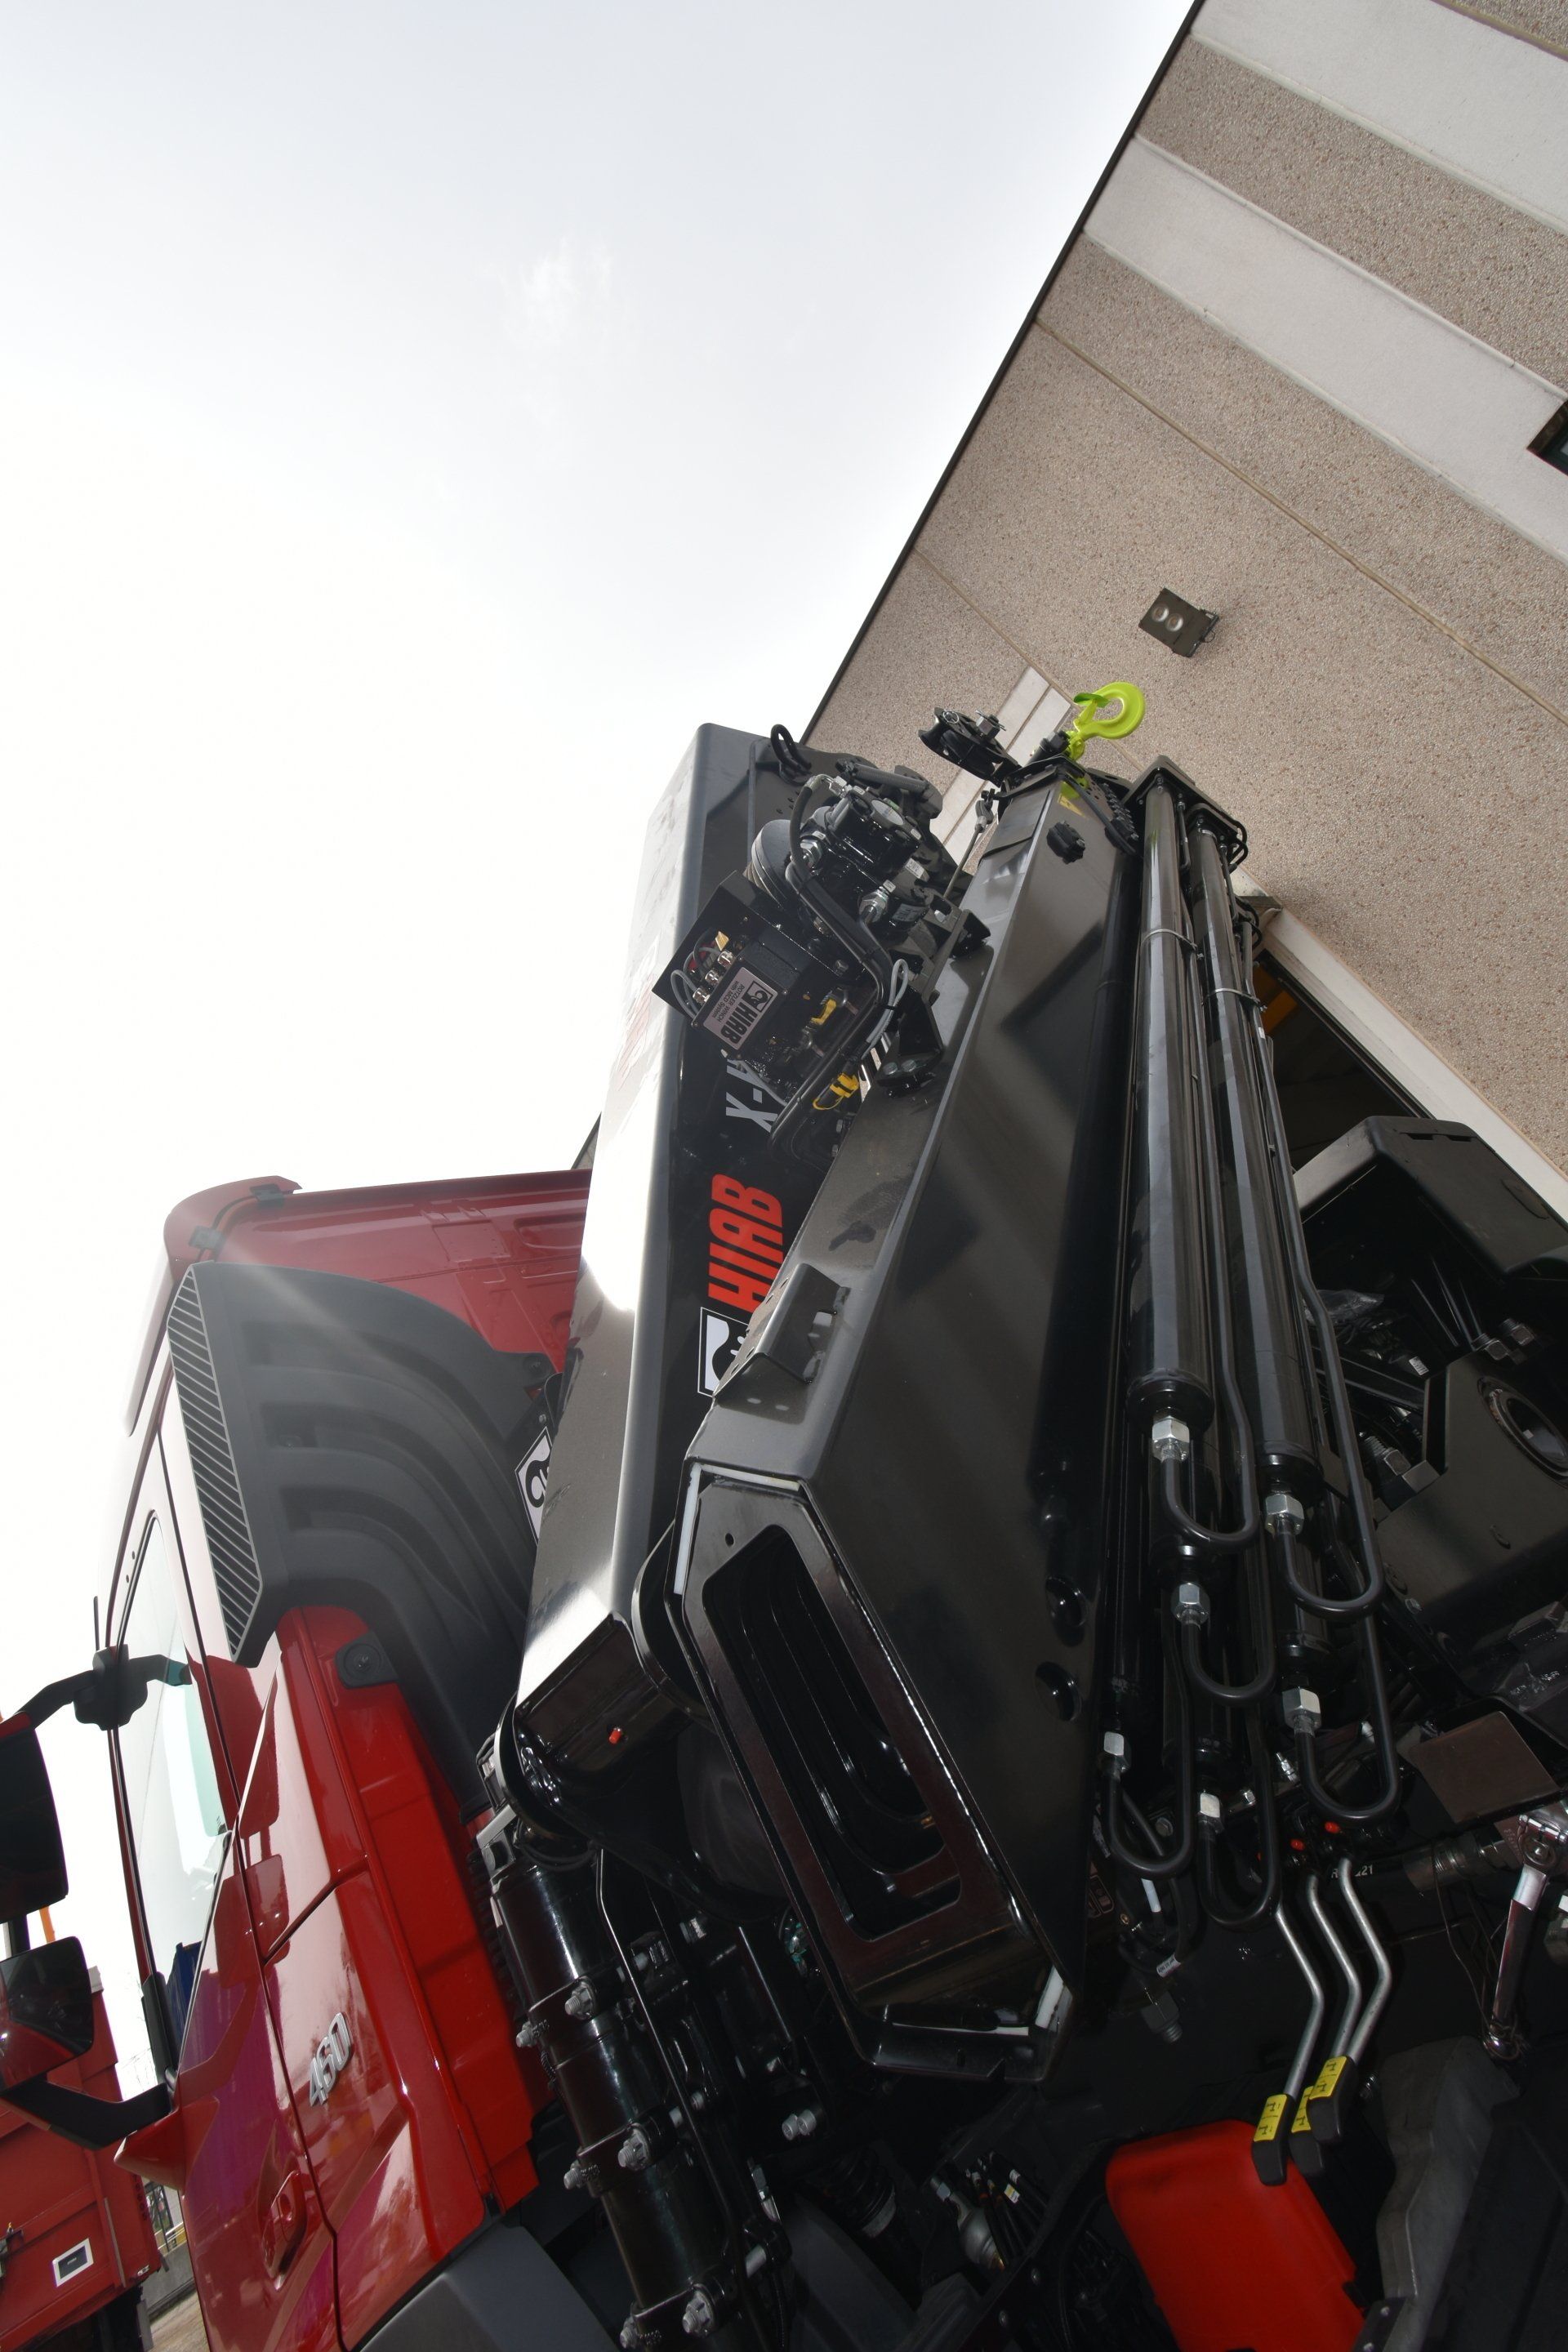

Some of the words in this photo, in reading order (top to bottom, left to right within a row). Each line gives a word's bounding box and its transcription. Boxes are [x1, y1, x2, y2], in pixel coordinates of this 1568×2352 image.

[728, 983, 746, 1006] ROTZLER
[731, 981, 739, 991] with
[724, 990, 733, 1003] MCD
[711, 1001, 725, 1018] System
[719, 1005, 731, 1023] WINCH
[720, 1001, 758, 1044] HIAB
[708, 1173, 784, 1314] HIAB
